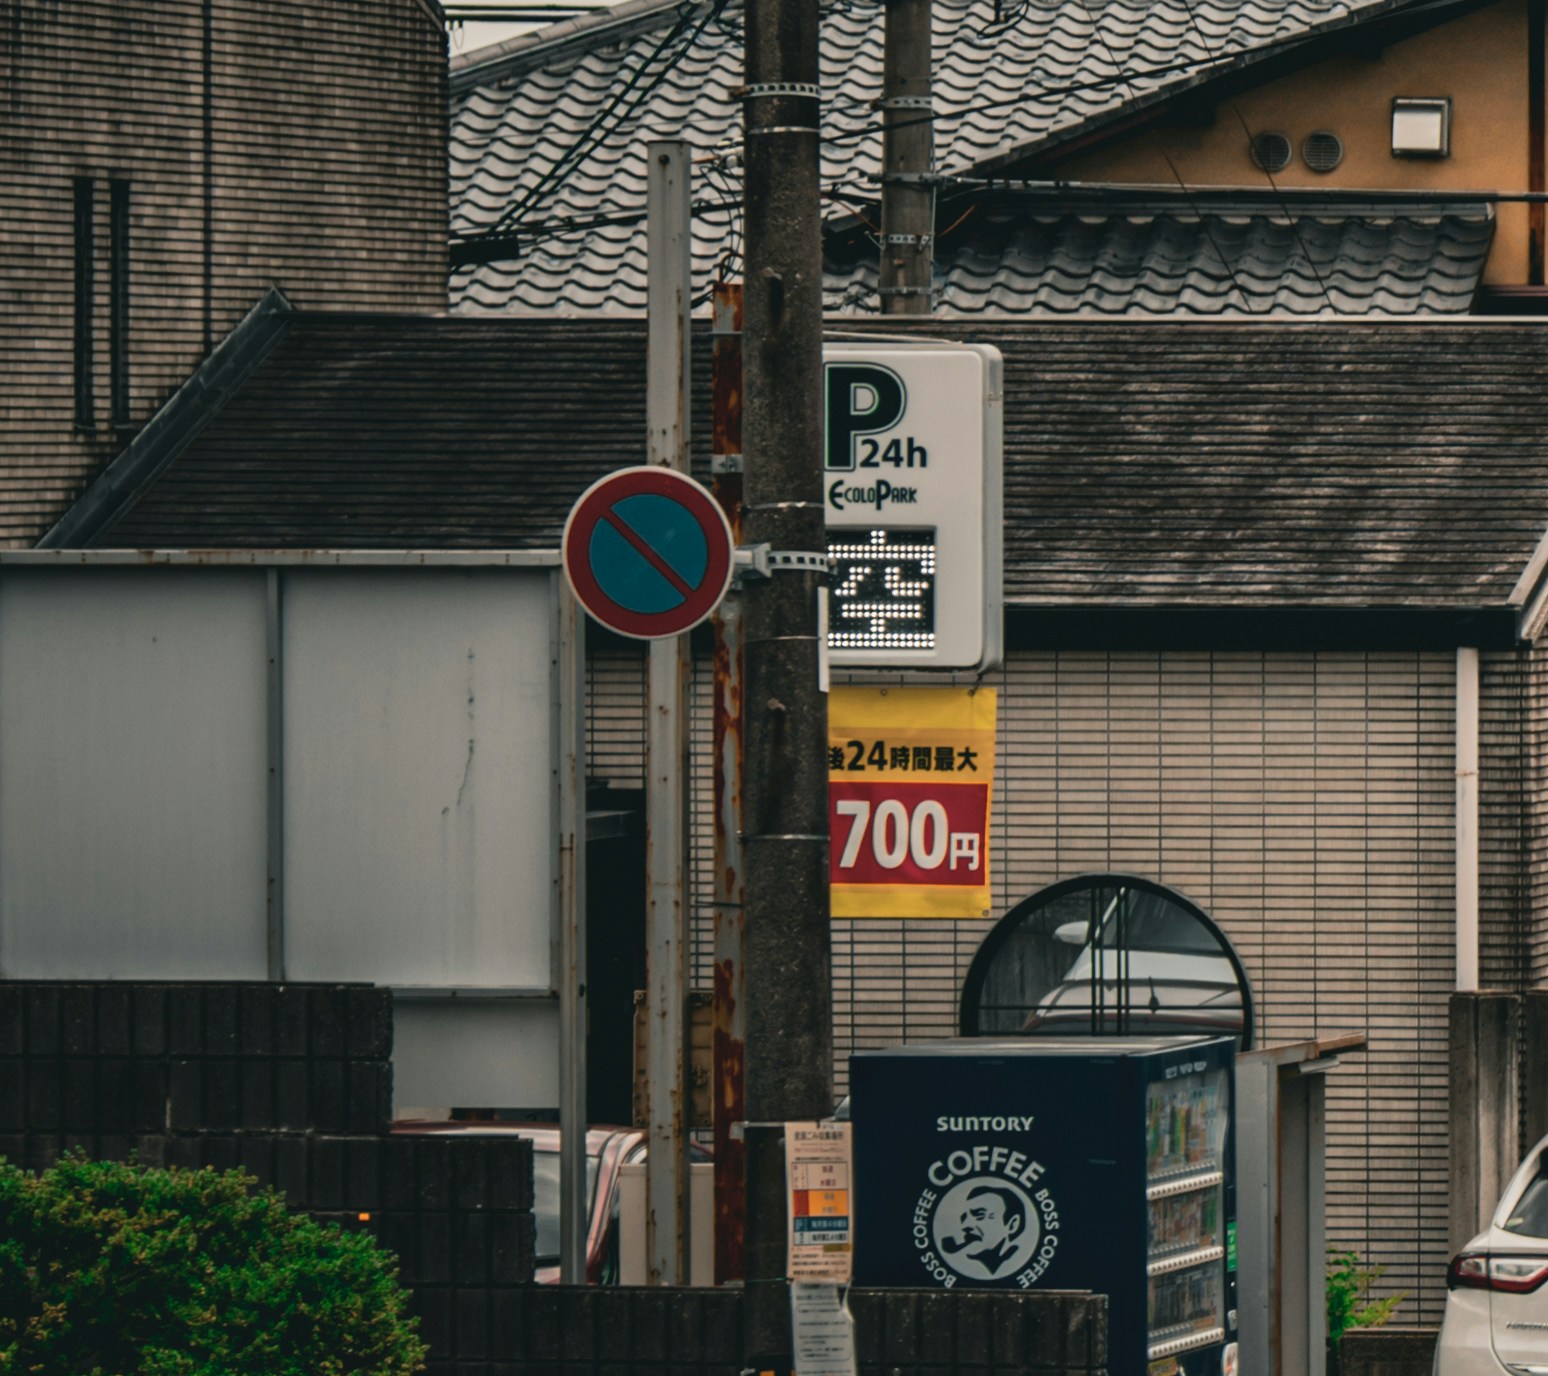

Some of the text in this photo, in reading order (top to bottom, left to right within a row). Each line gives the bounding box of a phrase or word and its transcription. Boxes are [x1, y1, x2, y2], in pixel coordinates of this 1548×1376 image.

[824, 362, 906, 471] P
[859, 437, 927, 468] 24h
[828, 530, 935, 647] 空
[836, 799, 980, 871] 700円
[928, 1146, 1045, 1189] COFFEE
[913, 1188, 957, 1289] BOSS COFFEE
[1016, 1188, 1059, 1289] BOSS COFFEE
